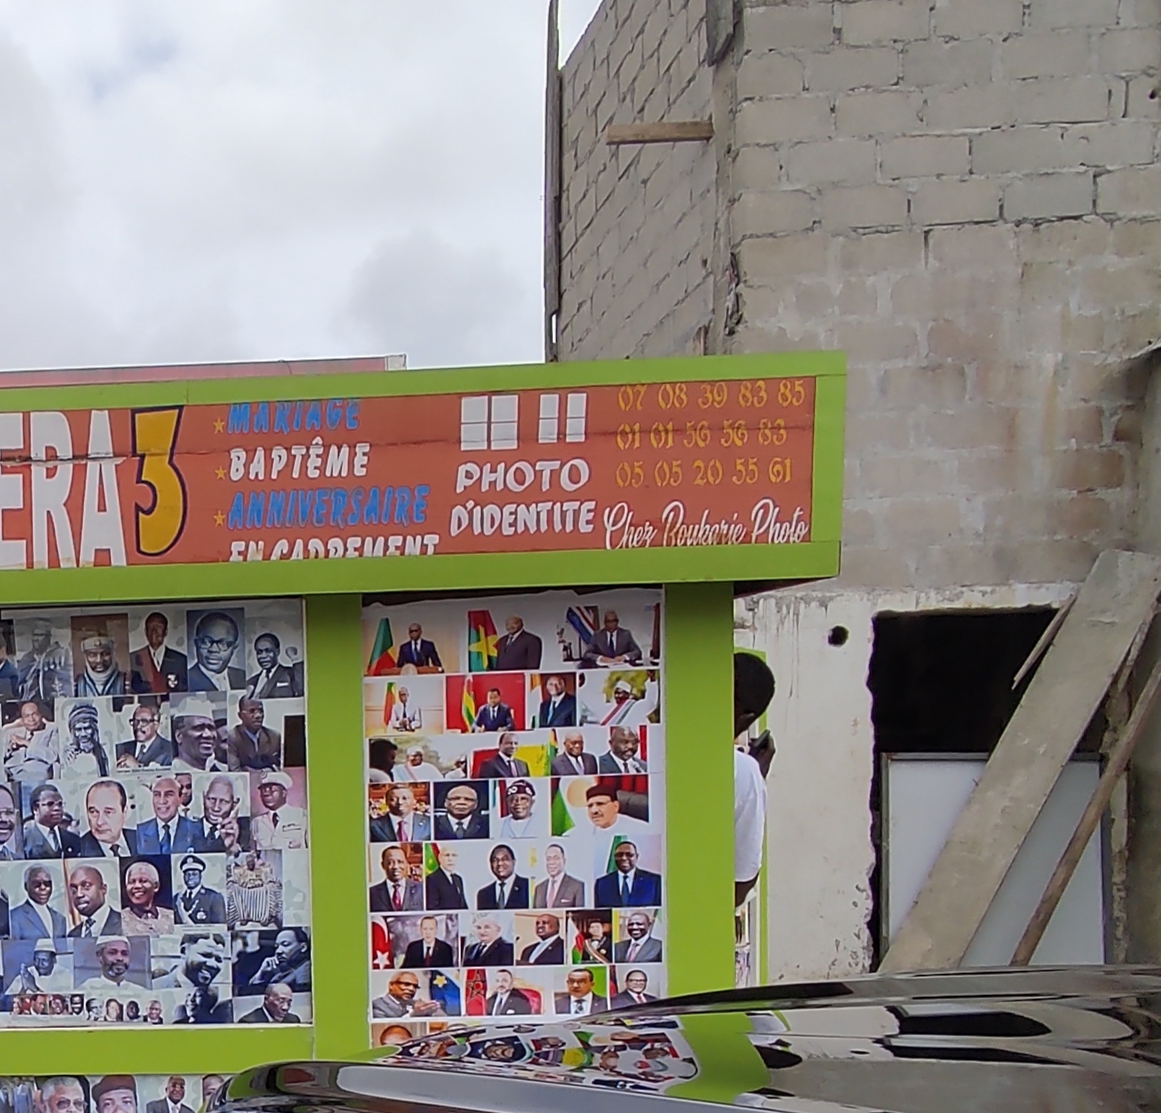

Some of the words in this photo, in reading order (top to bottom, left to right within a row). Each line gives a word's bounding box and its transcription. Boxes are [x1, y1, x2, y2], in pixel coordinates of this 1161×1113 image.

[618, 384, 647, 411] 07
[658, 382, 688, 410] 08
[698, 381, 728, 409] 39
[738, 380, 768, 408] 83
[778, 379, 806, 407] 85
[227, 398, 361, 435] MARIAGE
[616, 422, 641, 450] 01
[649, 421, 675, 449] 01
[683, 420, 711, 448] 56
[720, 419, 749, 447] 56
[757, 418, 788, 446] 83
[229, 437, 371, 481] BAPTÊME
[456, 458, 590, 494] PHOTO
[615, 461, 644, 488] 05
[654, 459, 683, 487] 05
[692, 459, 724, 486] 20
[732, 457, 759, 485] 55
[768, 457, 793, 484] 61
[227, 484, 430, 529] ANNIVERSAIRE
[450, 500, 596, 537] D'IDENTITE
[603, 502, 658, 550] Chez
[750, 498, 809, 545] Photo
